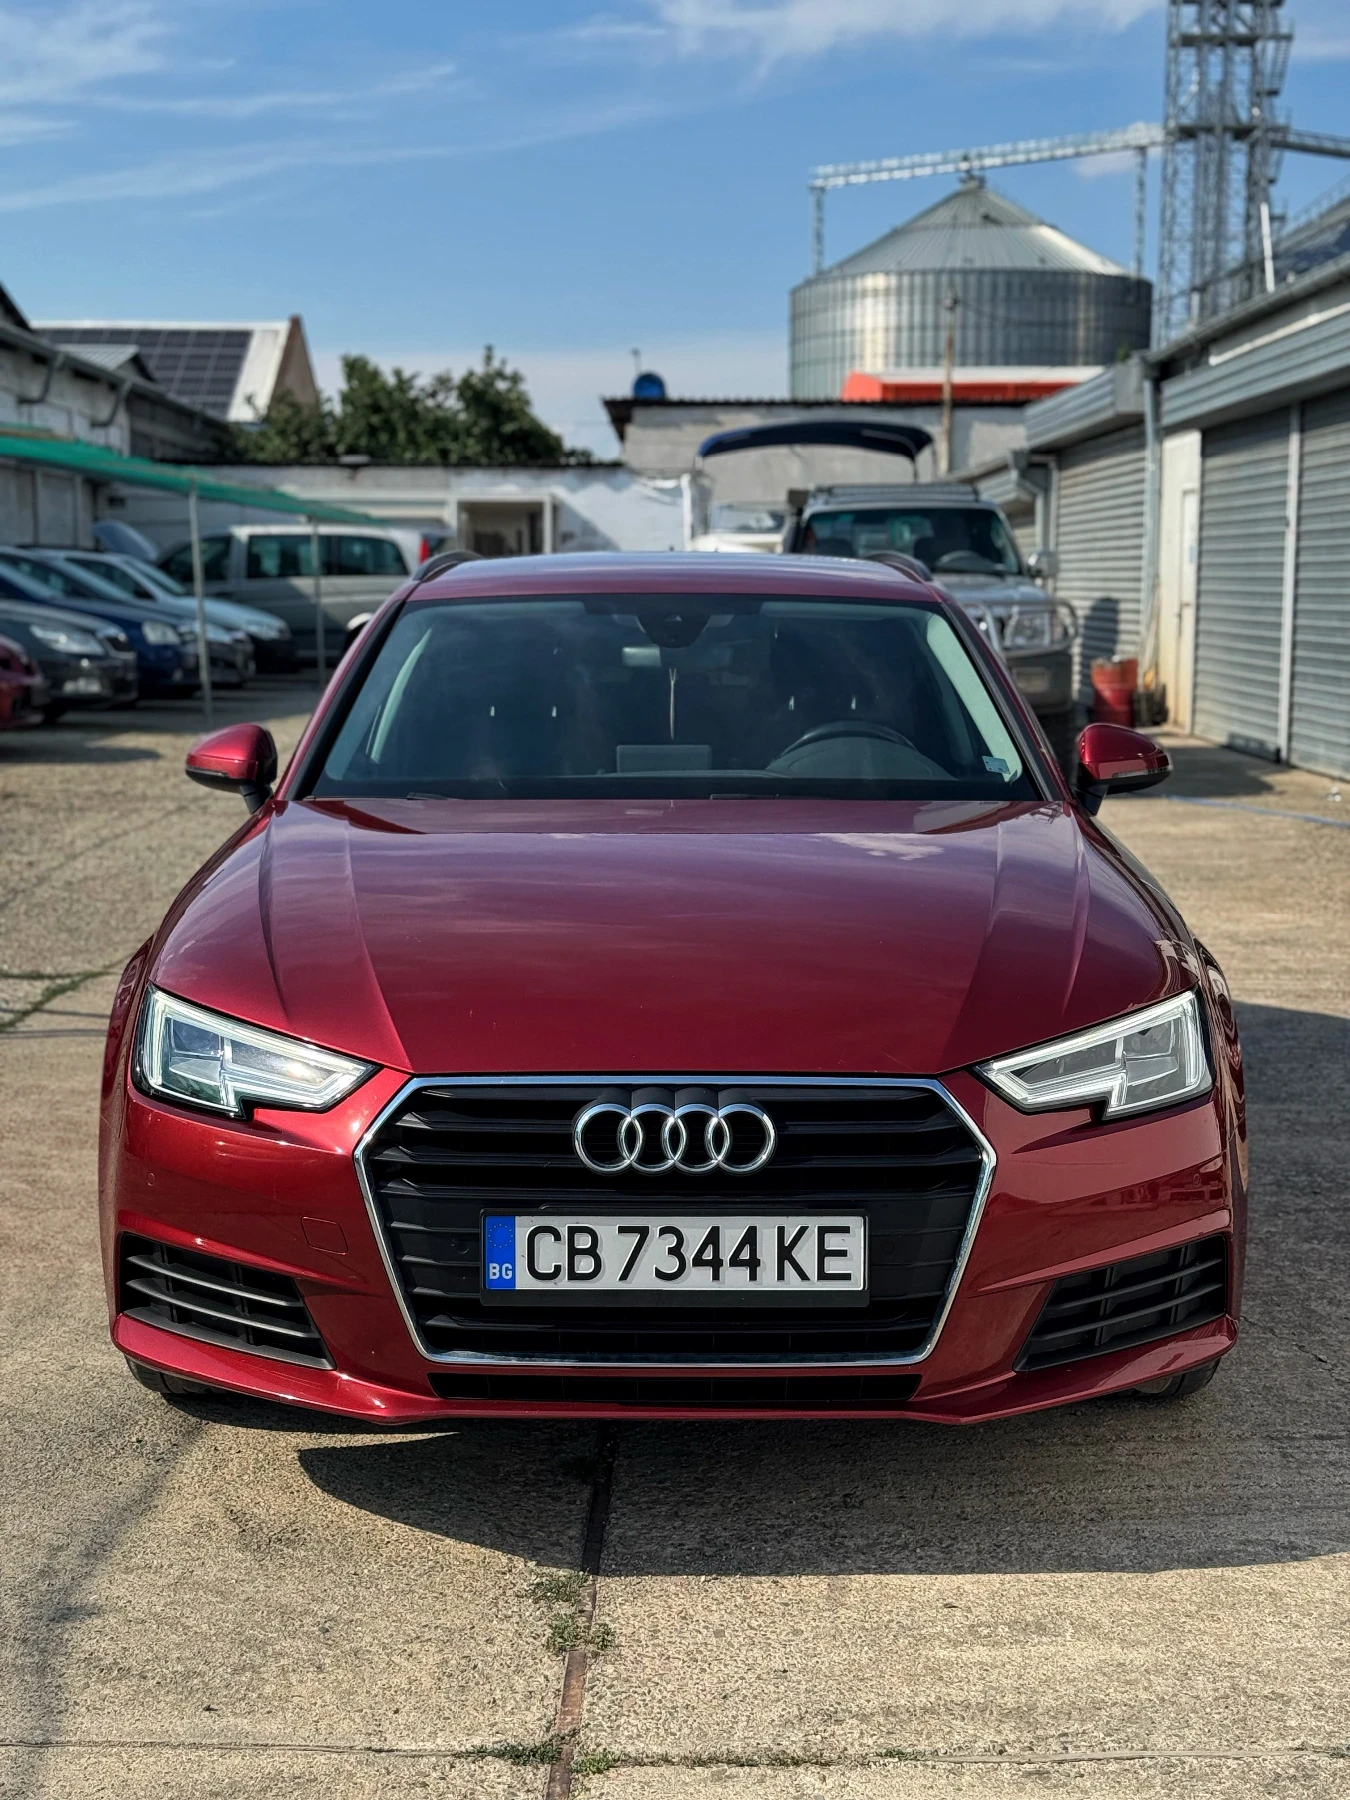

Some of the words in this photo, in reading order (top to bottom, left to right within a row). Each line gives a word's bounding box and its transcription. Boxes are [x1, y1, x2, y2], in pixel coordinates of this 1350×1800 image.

[526, 1225, 601, 1281] CB
[617, 1225, 761, 1281] 7344
[777, 1225, 852, 1281] KE
[489, 1263, 512, 1280] BG
